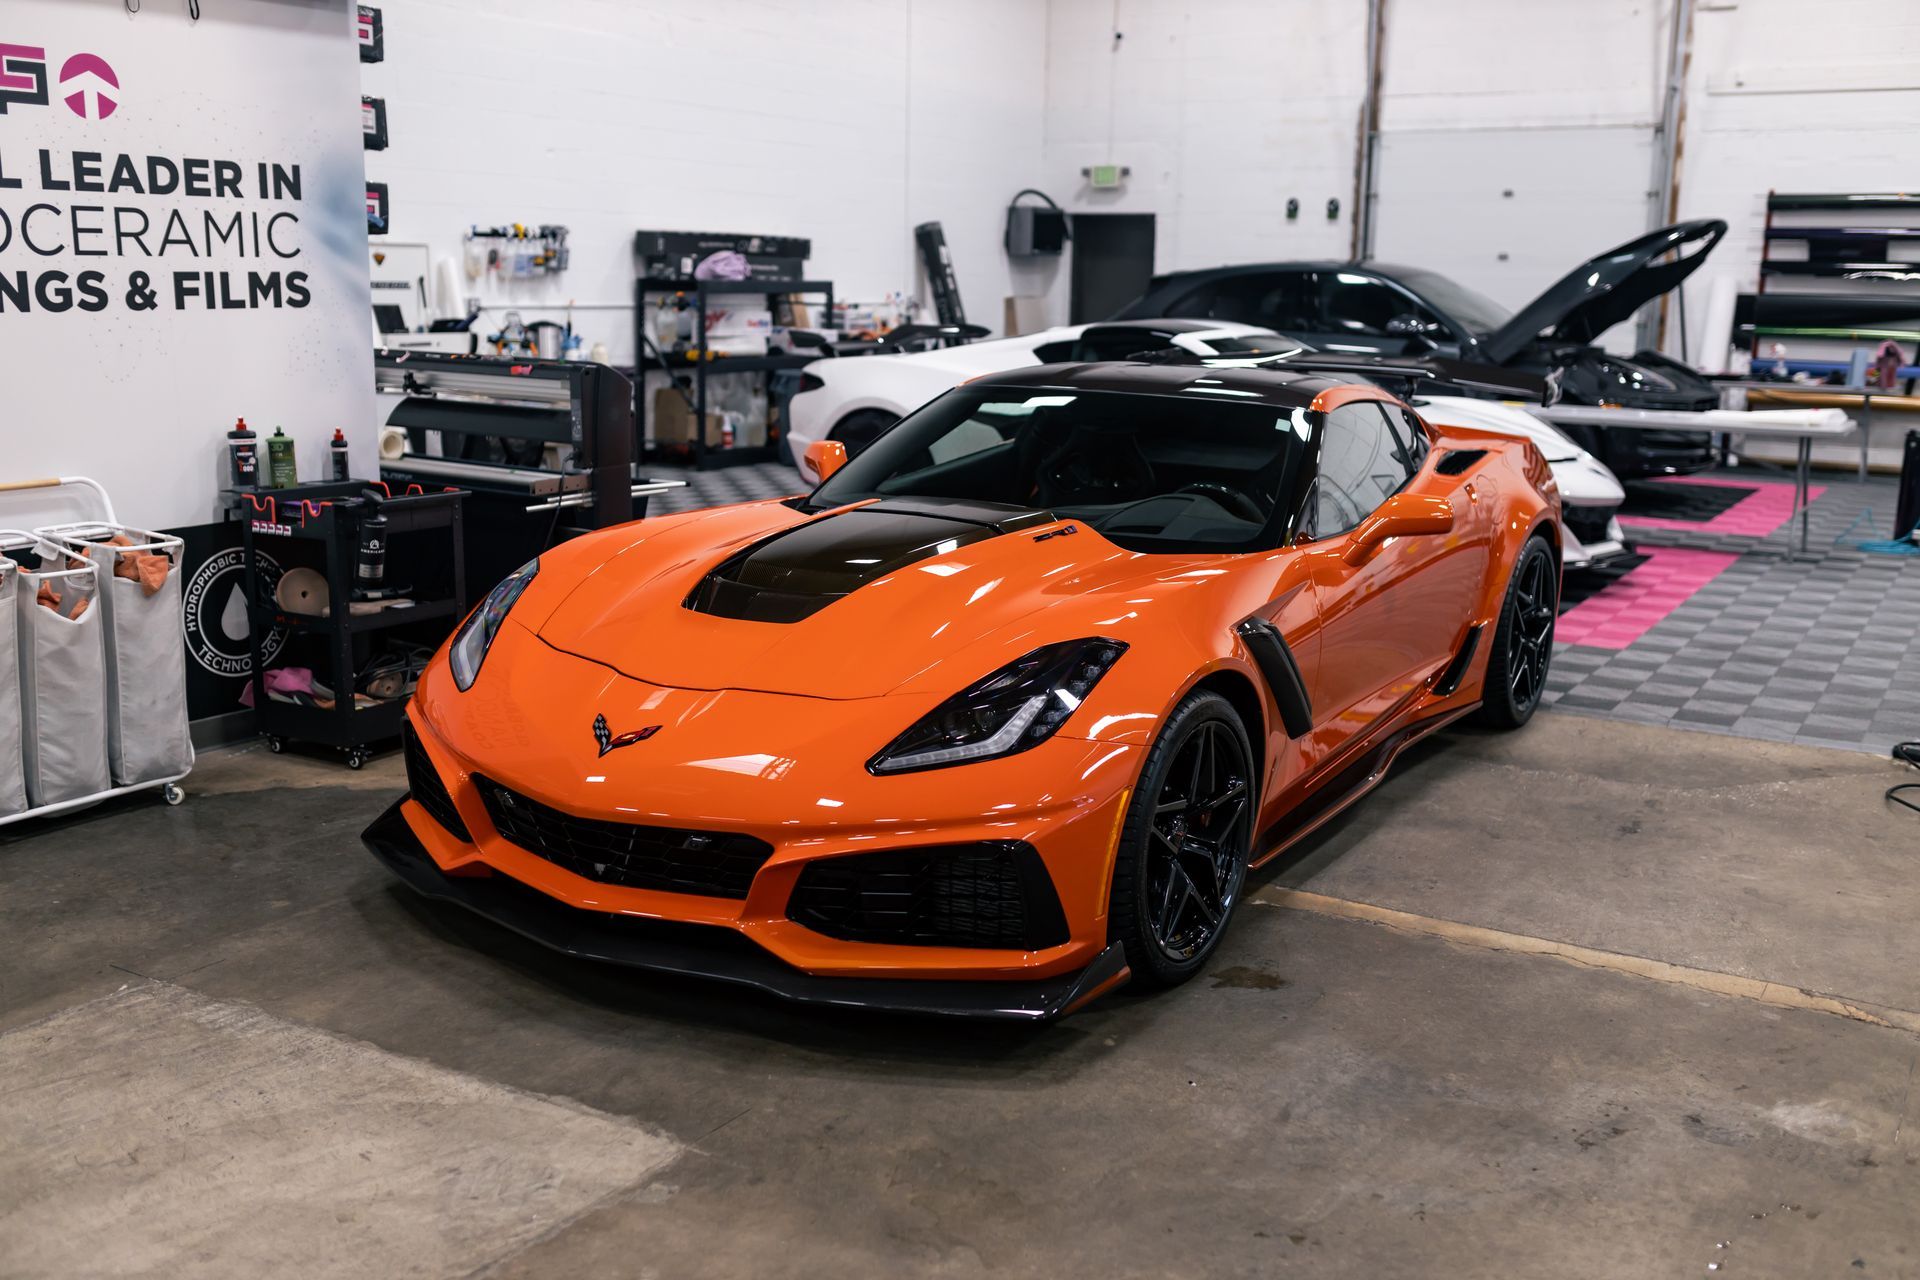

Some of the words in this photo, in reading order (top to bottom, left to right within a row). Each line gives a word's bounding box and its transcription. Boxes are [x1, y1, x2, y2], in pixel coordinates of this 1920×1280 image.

[39, 148, 244, 199] LEADER
[258, 163, 302, 200] IN
[126, 270, 158, 312] &
[173, 271, 311, 310] FILMS
[186, 553, 237, 632] HYDROPHOBIC
[198, 630, 282, 672] TECHNOOGY
